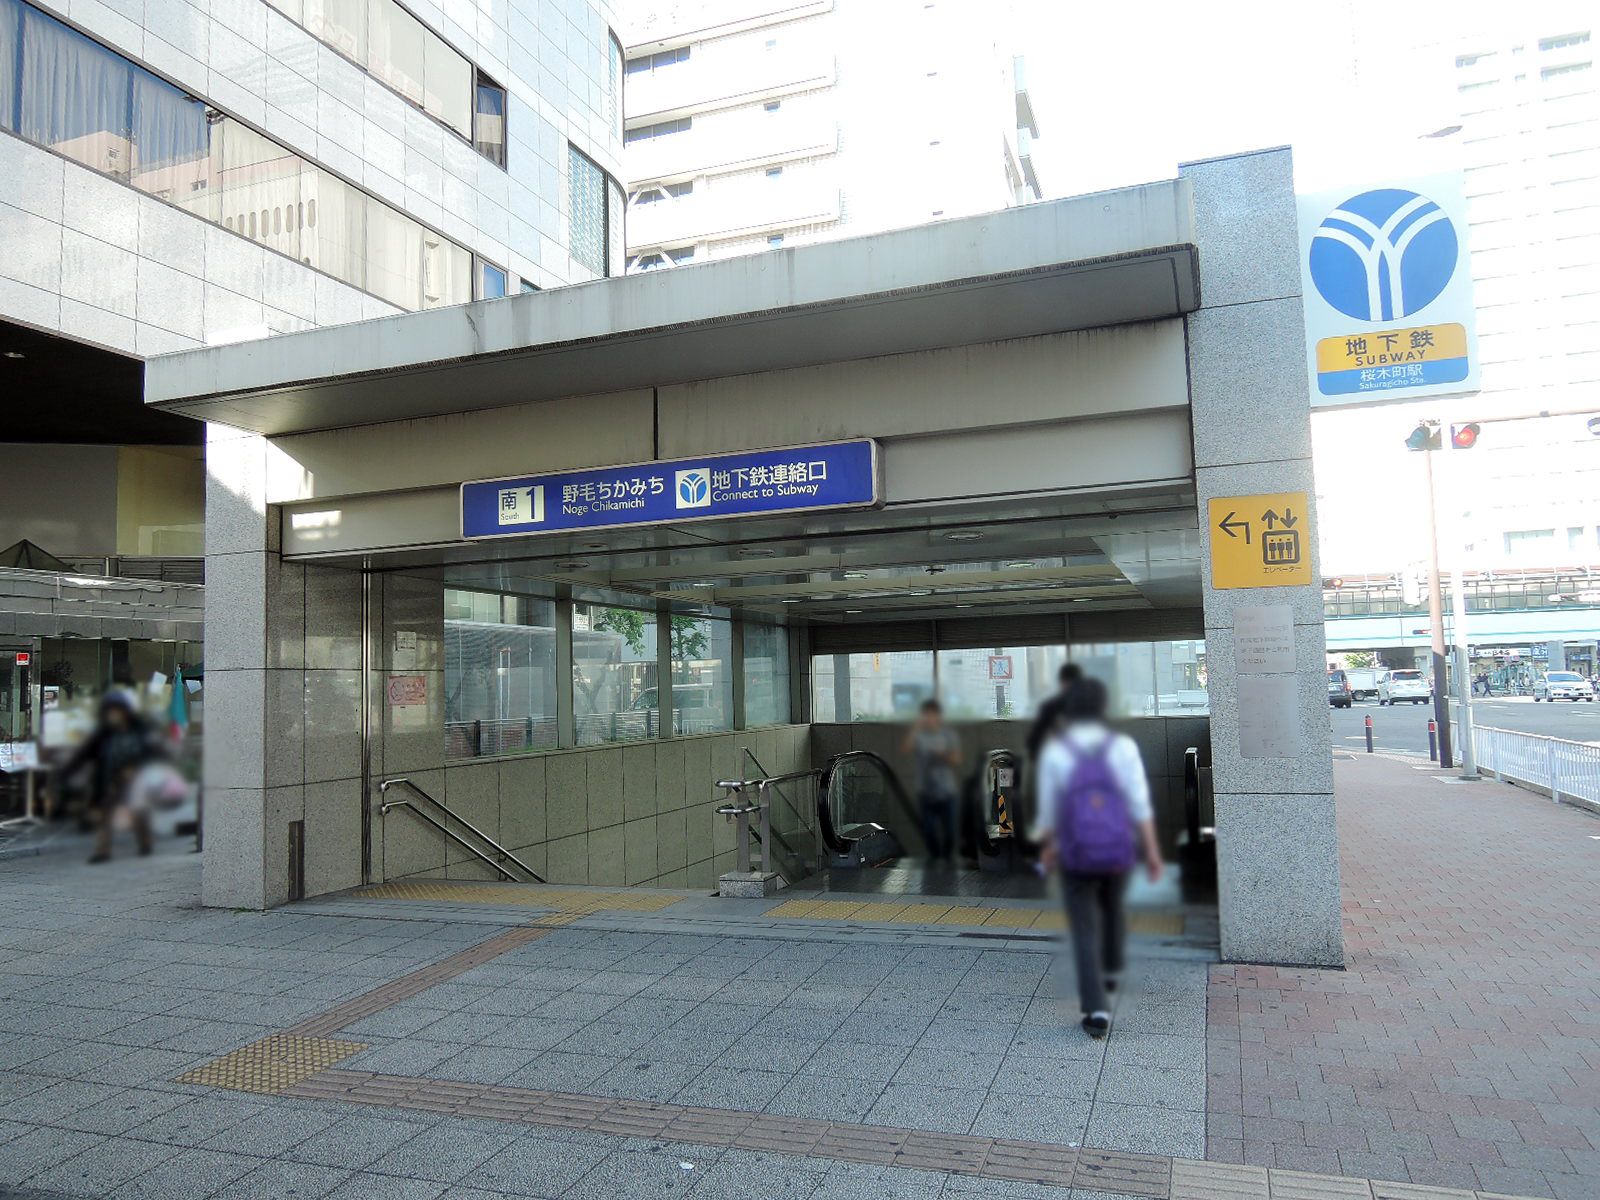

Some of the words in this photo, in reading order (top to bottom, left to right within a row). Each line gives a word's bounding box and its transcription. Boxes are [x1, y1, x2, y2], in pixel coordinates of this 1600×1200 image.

[1345, 329, 1434, 356] 地下鉄
[1355, 349, 1426, 367] SUBWAY
[1360, 363, 1424, 382] 桜木町駅
[712, 461, 827, 490] 地下鉄連絡口
[562, 476, 664, 504] 野毛ちかみち
[712, 489, 759, 502] Connect
[761, 487, 774, 497] to
[777, 484, 819, 496] Subway
[501, 491, 517, 512] 南
[526, 487, 536, 520] 1
[562, 504, 589, 516] Noge
[591, 497, 645, 513] Chikamichi
[500, 512, 520, 521] South
[1262, 566, 1302, 574] エレベーター
